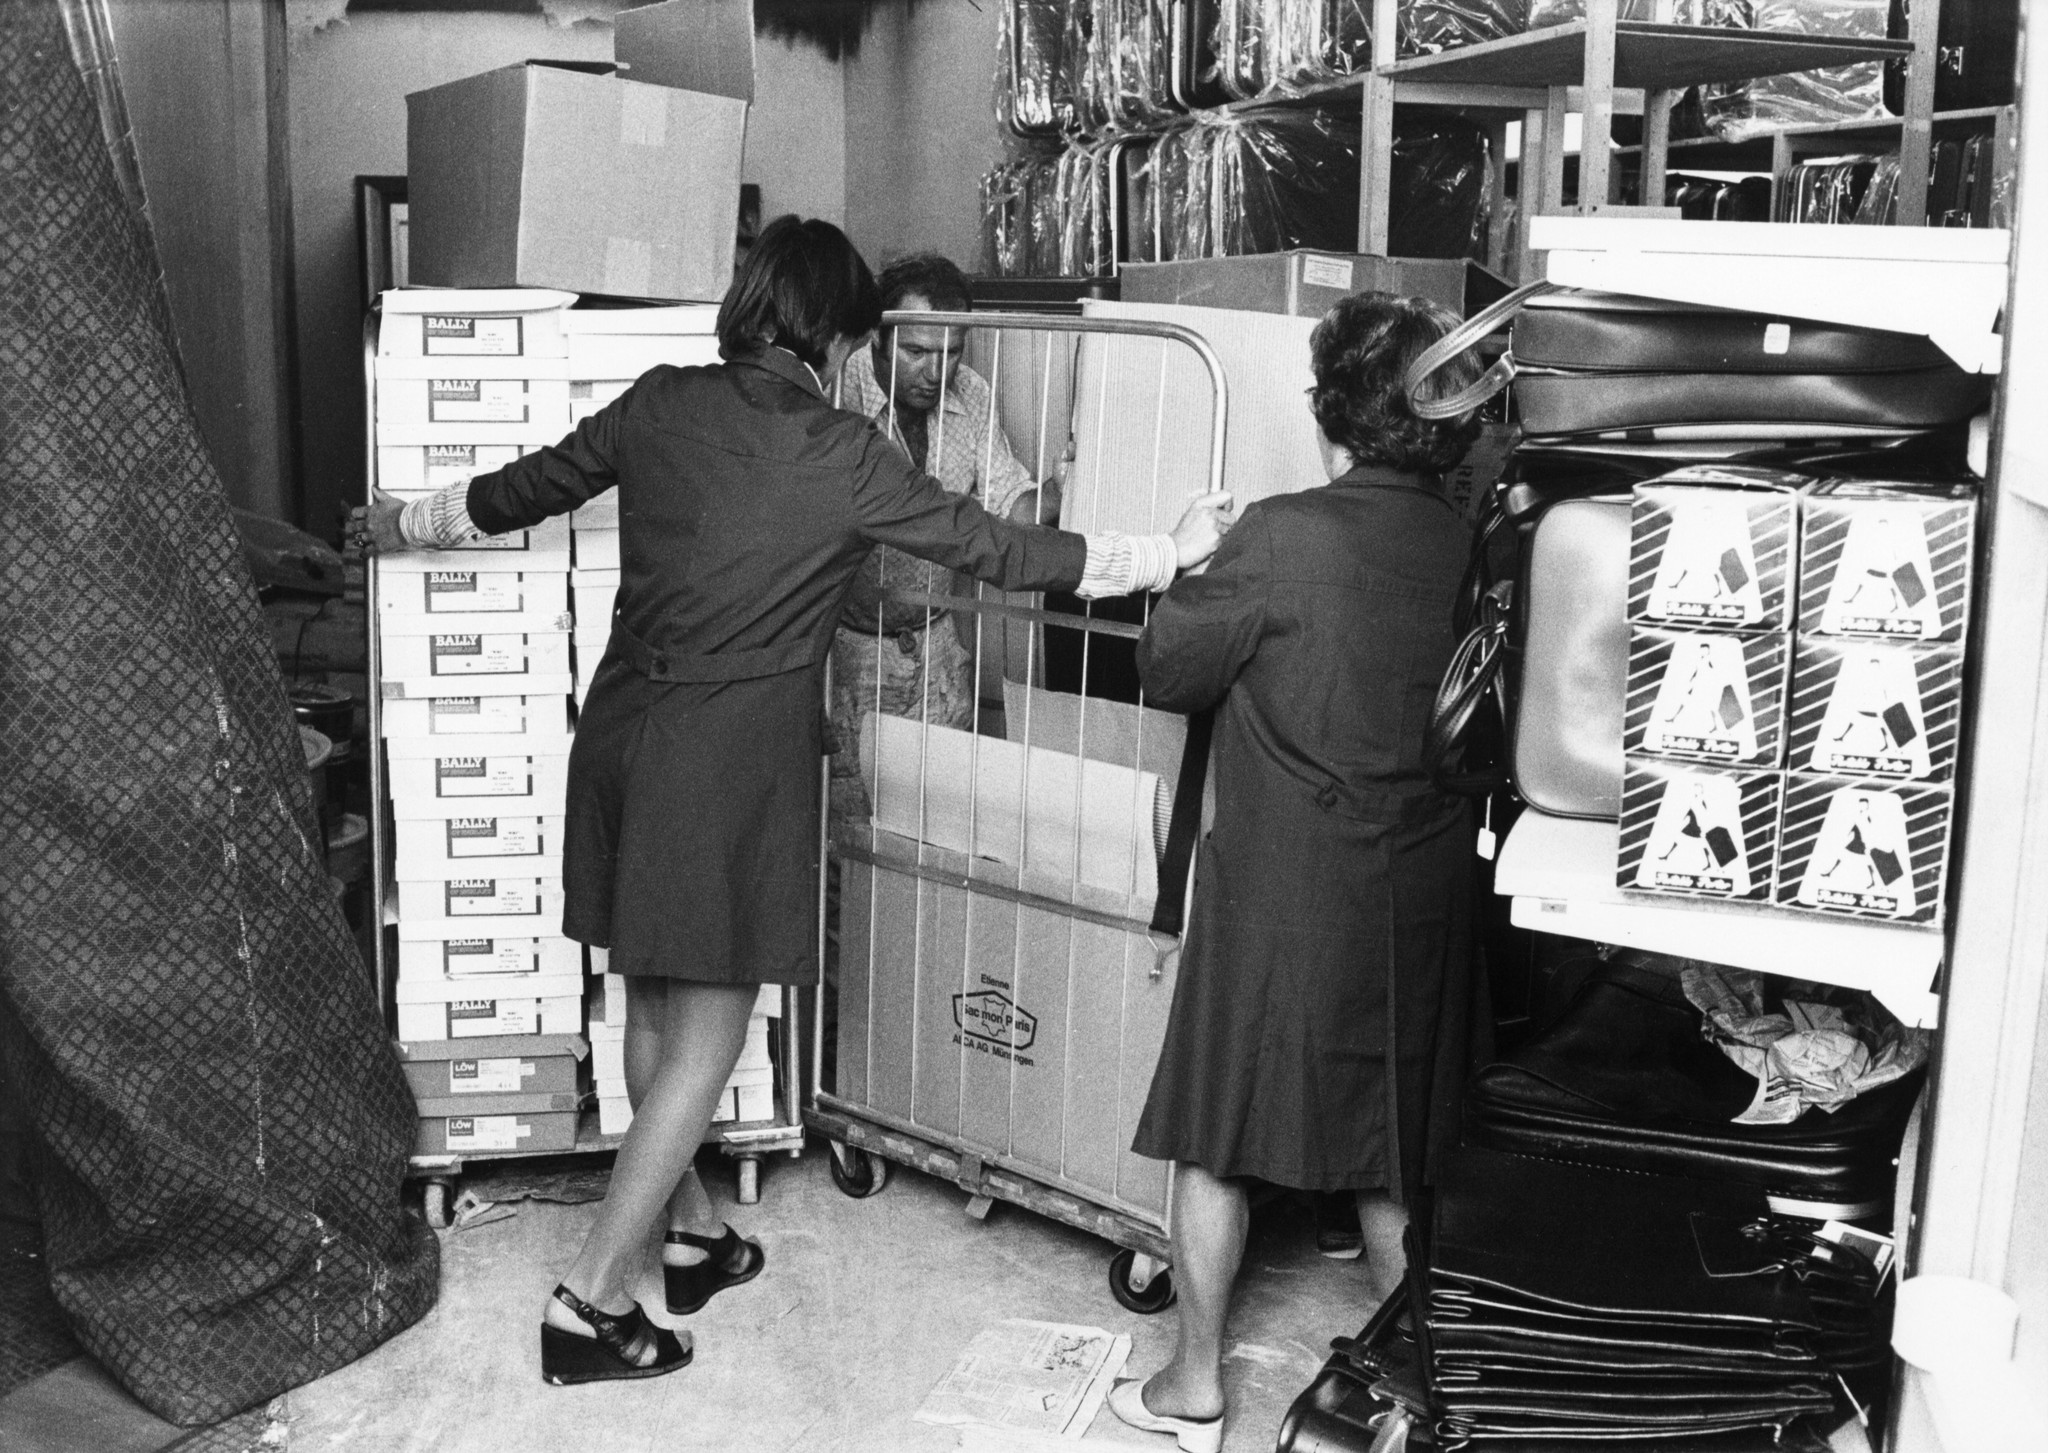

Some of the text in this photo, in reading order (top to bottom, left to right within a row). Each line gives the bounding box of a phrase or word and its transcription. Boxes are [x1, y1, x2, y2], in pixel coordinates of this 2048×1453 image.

[428, 317, 472, 329] BALLY
[433, 380, 478, 392] BALLY
[428, 445, 473, 457] BALLY
[430, 572, 474, 583] BALLY
[435, 635, 479, 646] BALLY
[440, 757, 483, 768] BALLY
[451, 818, 494, 829] BALLY
[980, 973, 1010, 990] Etienne
[451, 1000, 492, 1010] BALLY
[982, 1011, 1003, 1024] mon
[976, 1042, 989, 1053] AG
[992, 1046, 1034, 1067] Münsngen
